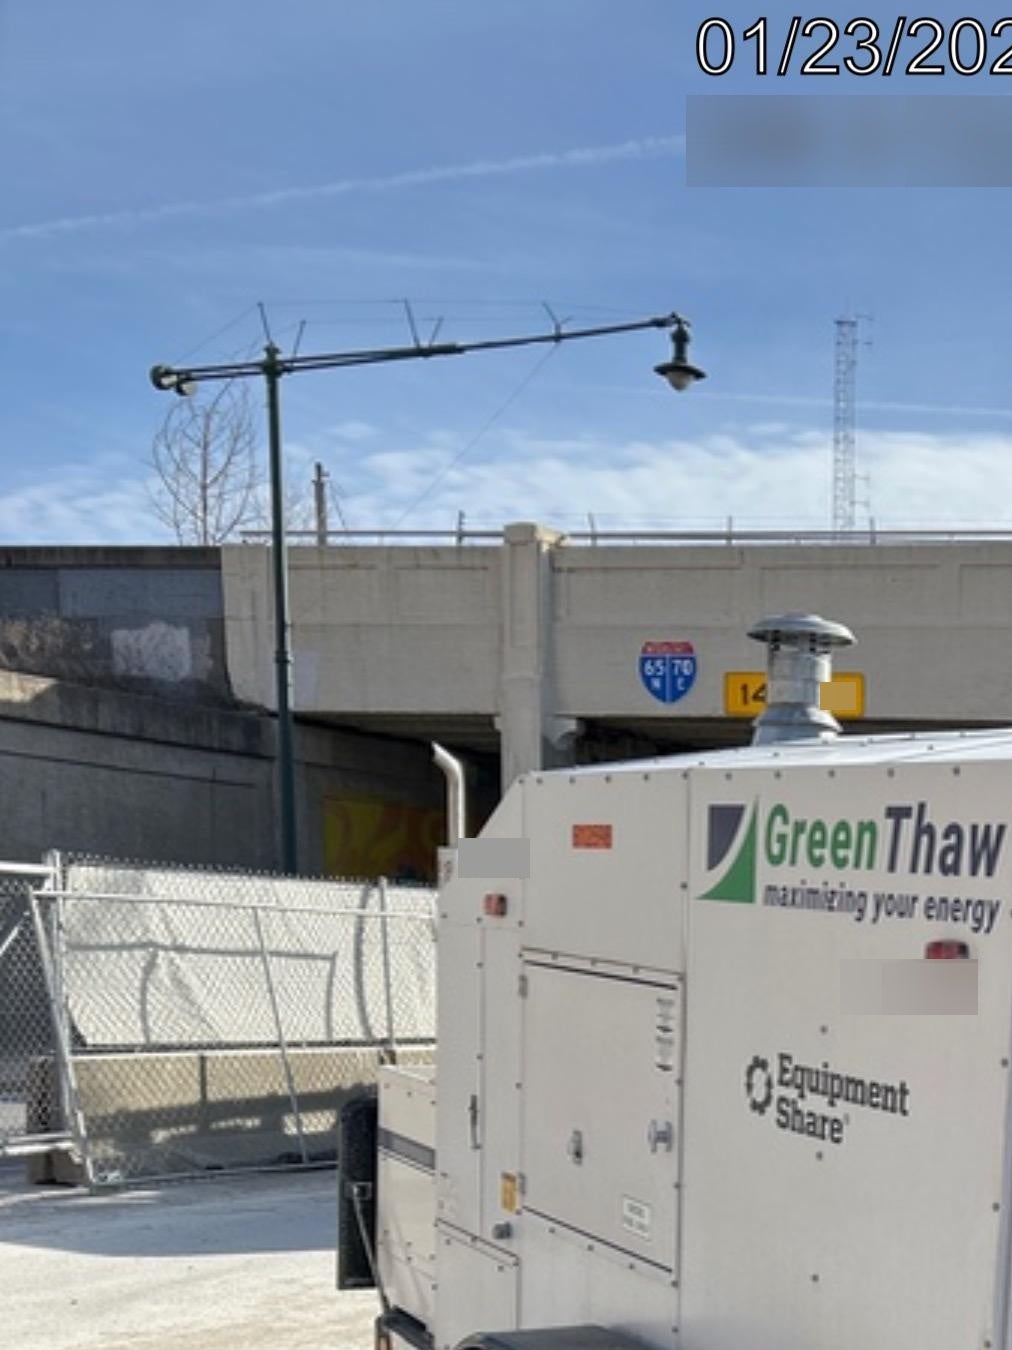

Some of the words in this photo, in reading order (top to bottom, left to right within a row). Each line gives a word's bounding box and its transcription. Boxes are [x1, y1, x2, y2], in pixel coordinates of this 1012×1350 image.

[644, 659, 664, 676] 65
[672, 659, 693, 676] 70
[762, 879, 869, 922] maximizing
[871, 893, 920, 924] your
[923, 897, 1001, 935] energy
[777, 1052, 910, 1117] Equipment
